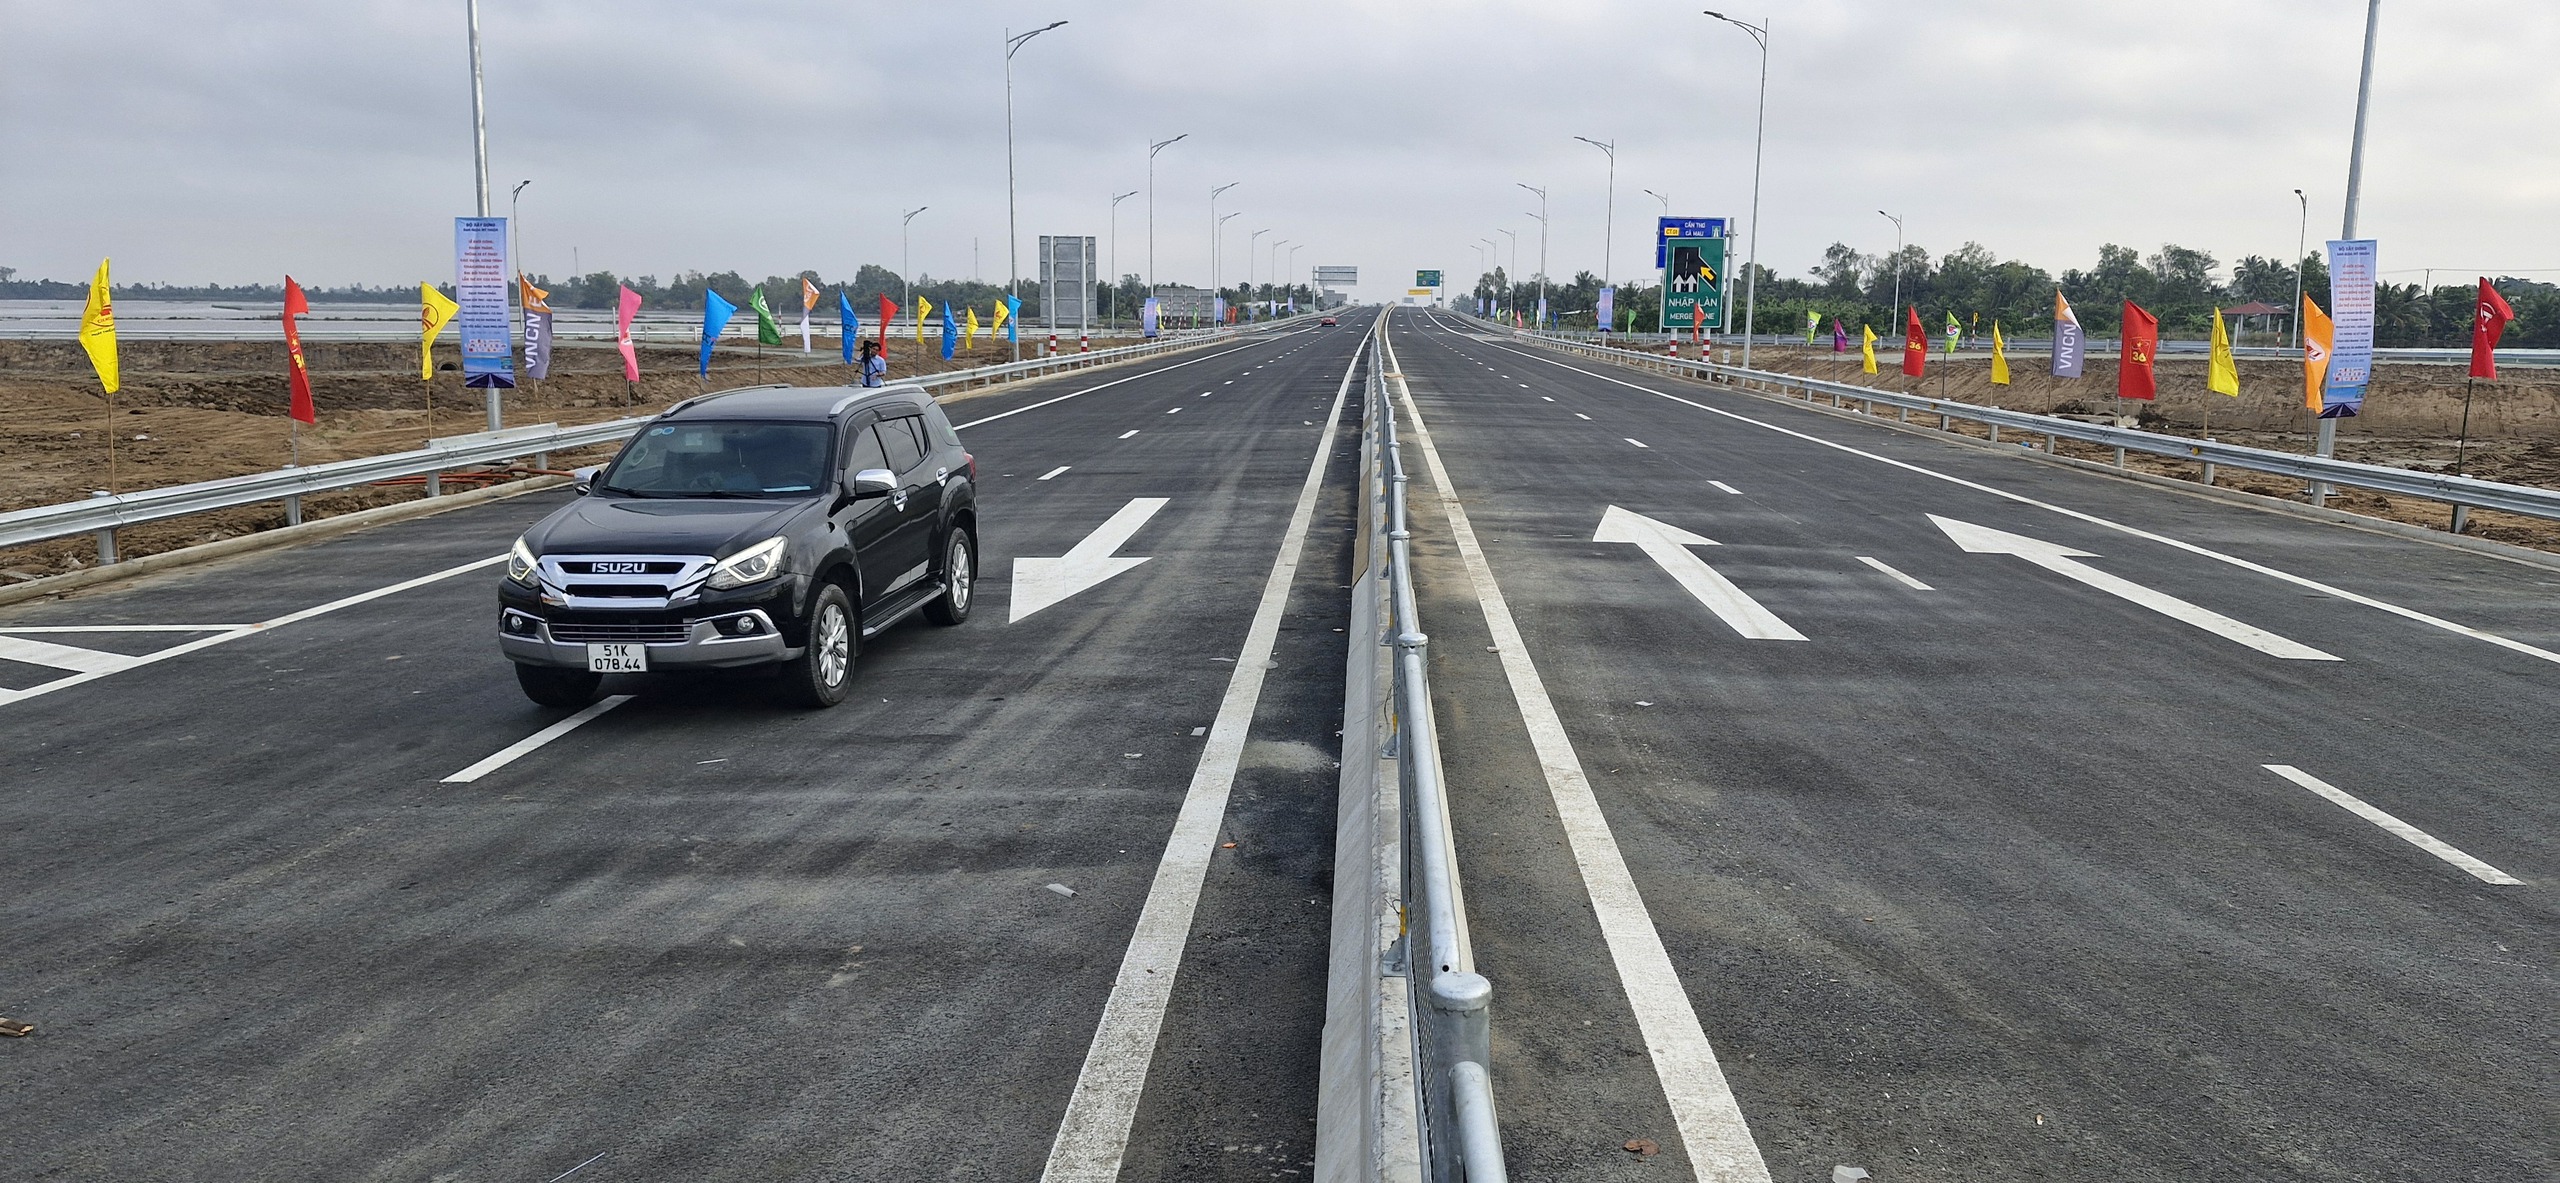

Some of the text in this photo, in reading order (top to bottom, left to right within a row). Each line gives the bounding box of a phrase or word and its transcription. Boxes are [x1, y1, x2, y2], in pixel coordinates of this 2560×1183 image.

[1669, 296, 1717, 308] NHẬP LÀN
[525, 313, 541, 368] VNCN
[1909, 341, 1922, 350] 36
[2059, 324, 2077, 370] VNCN
[2132, 352, 2147, 362] 36
[591, 562, 646, 573] ISUZU
[603, 645, 628, 657] 51K
[594, 658, 641, 671] 078.44
